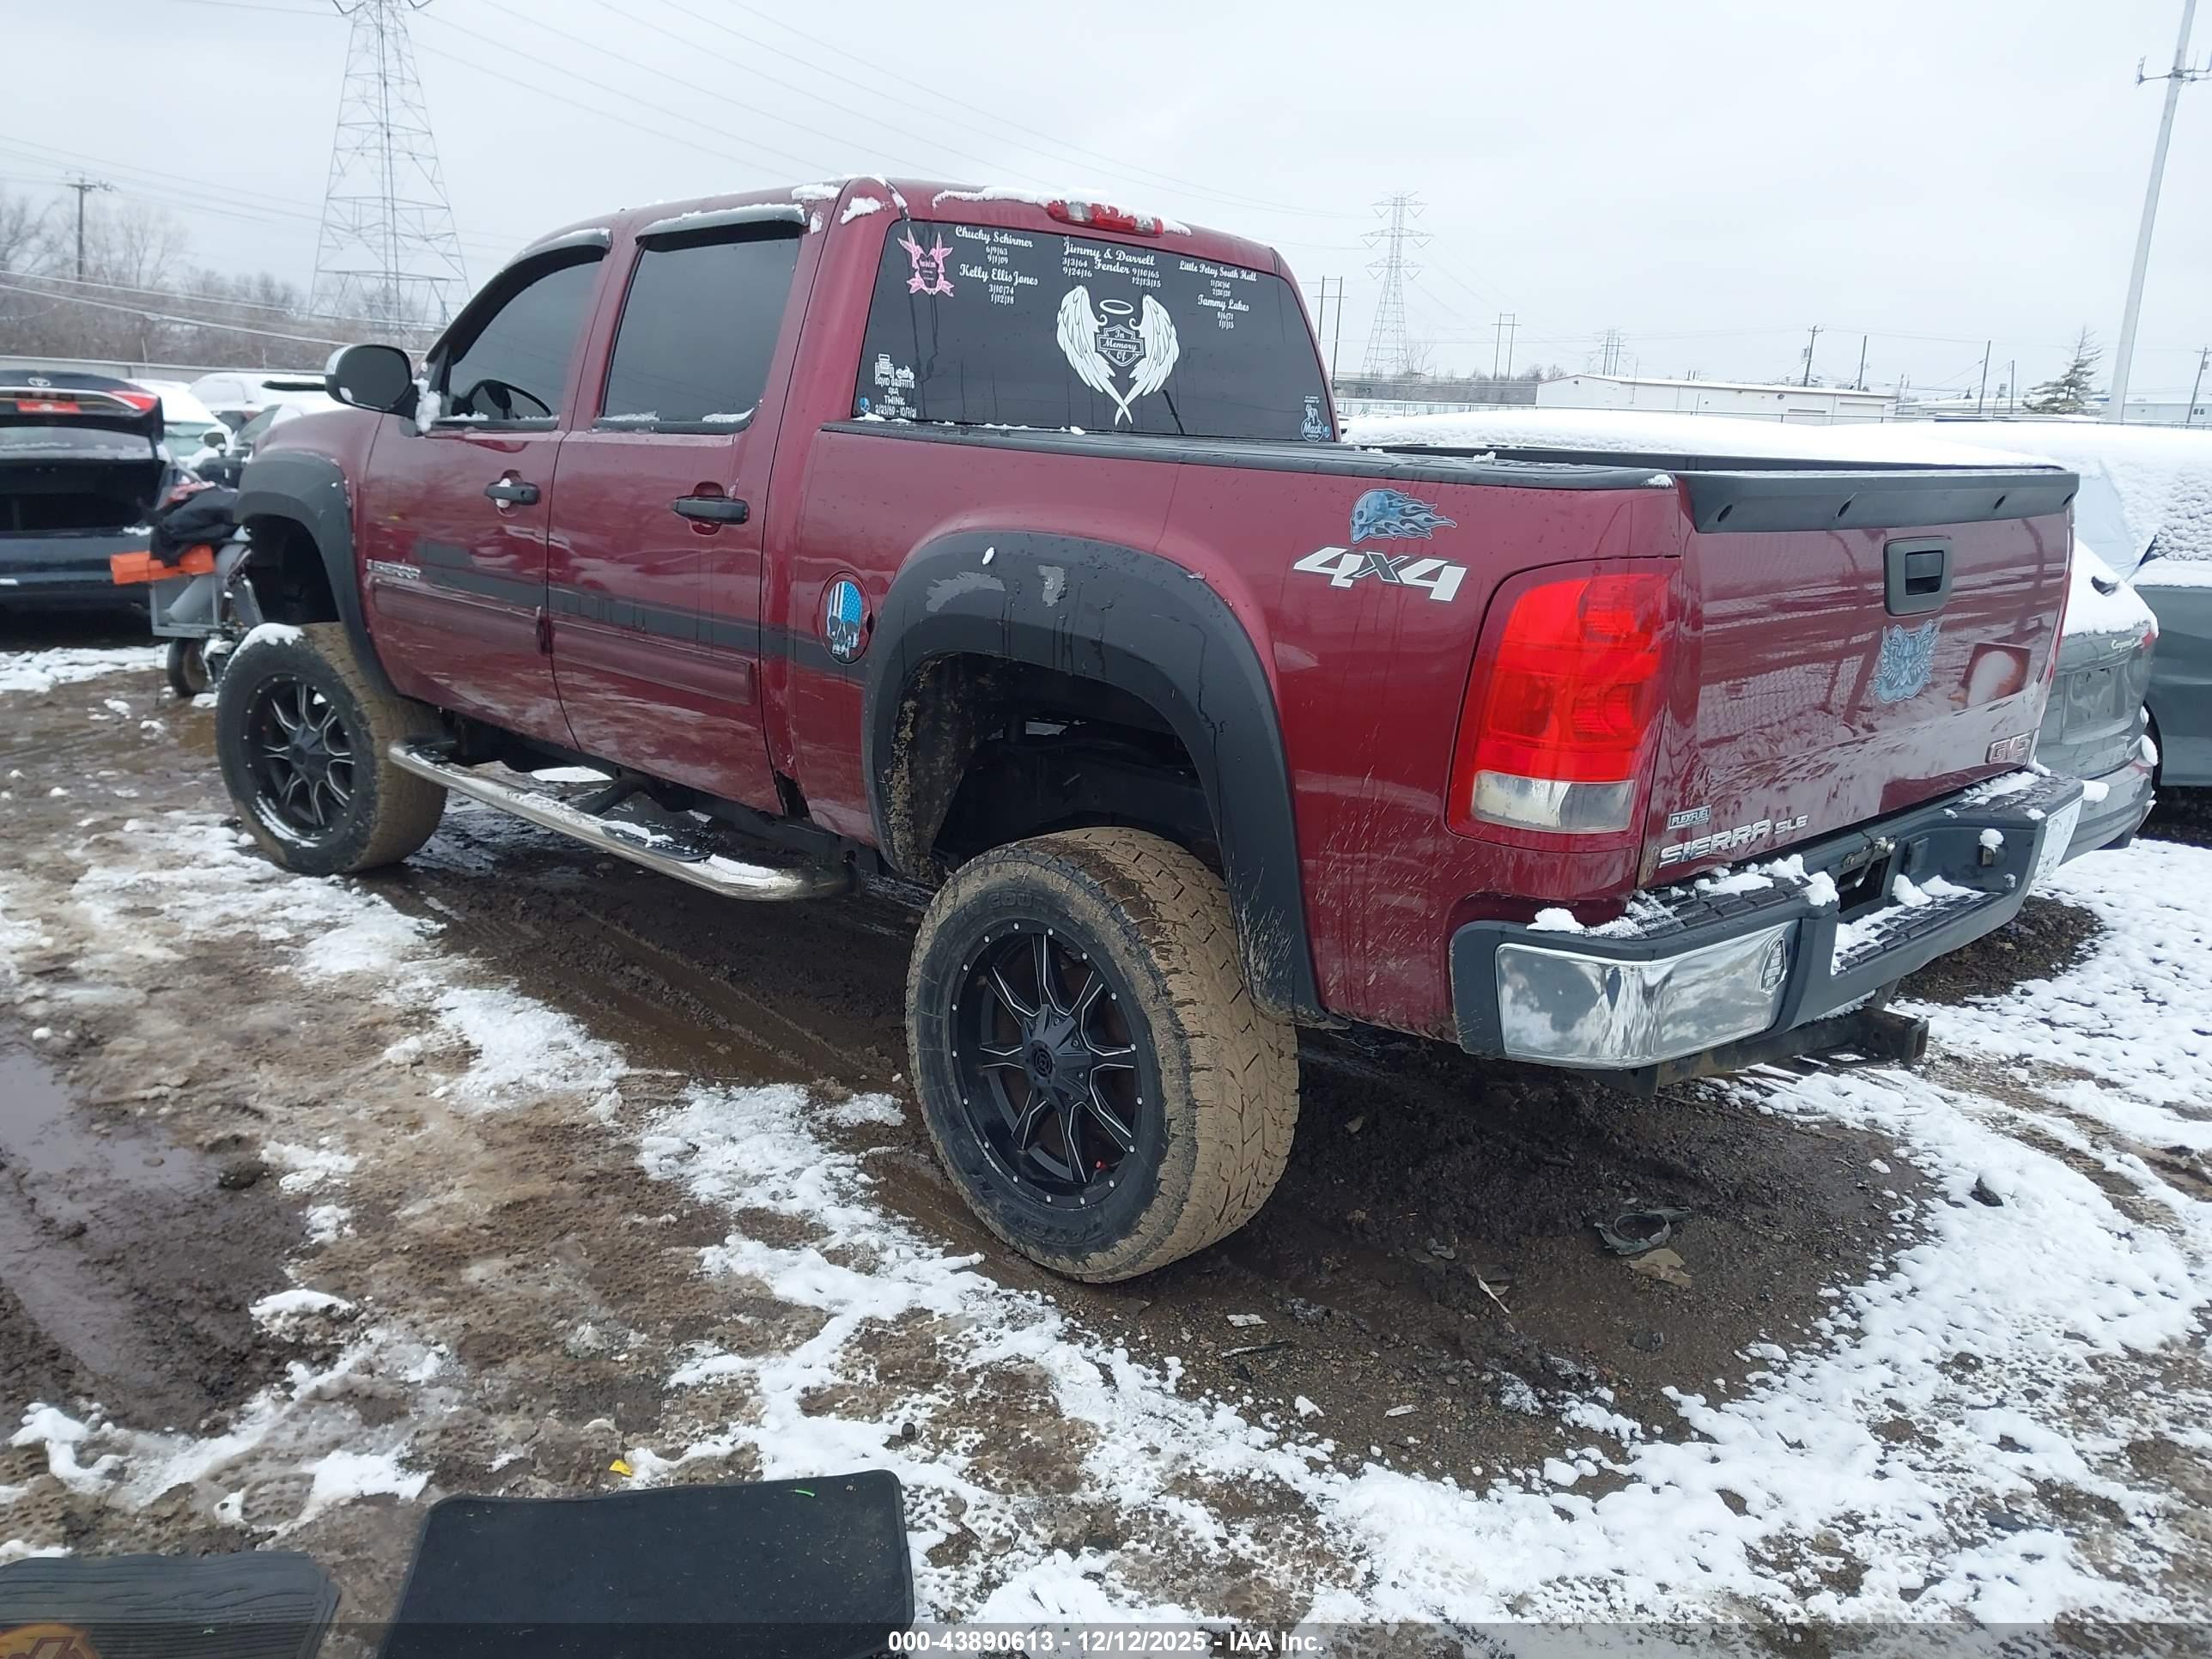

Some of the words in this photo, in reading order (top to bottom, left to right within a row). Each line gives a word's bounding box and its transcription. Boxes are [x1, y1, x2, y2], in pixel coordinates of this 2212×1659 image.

[955, 226, 991, 244] Chucky
[993, 231, 1033, 247] Schirmer
[986, 246, 1008, 256] 6/9/63
[1063, 240, 1101, 259] Jimmy
[1103, 248, 1113, 259] &
[1115, 249, 1155, 266] Darrell
[1061, 257, 1088, 269] 3/3/64
[1094, 259, 1130, 275] Fender
[1179, 260, 1198, 273] Little
[1219, 266, 1238, 279] South
[959, 264, 988, 283] Kelly
[991, 268, 1013, 283] Ellis
[1012, 270, 1038, 287] Jones
[1062, 266, 1092, 279] 9/24/16
[1197, 294, 1226, 312] Tammy
[1115, 329, 1125, 338] In
[1102, 338, 1137, 351] Memory
[1303, 421, 1322, 435] Mack
[1658, 818, 1771, 868] SIERRA
[1773, 815, 1808, 836] SLE
